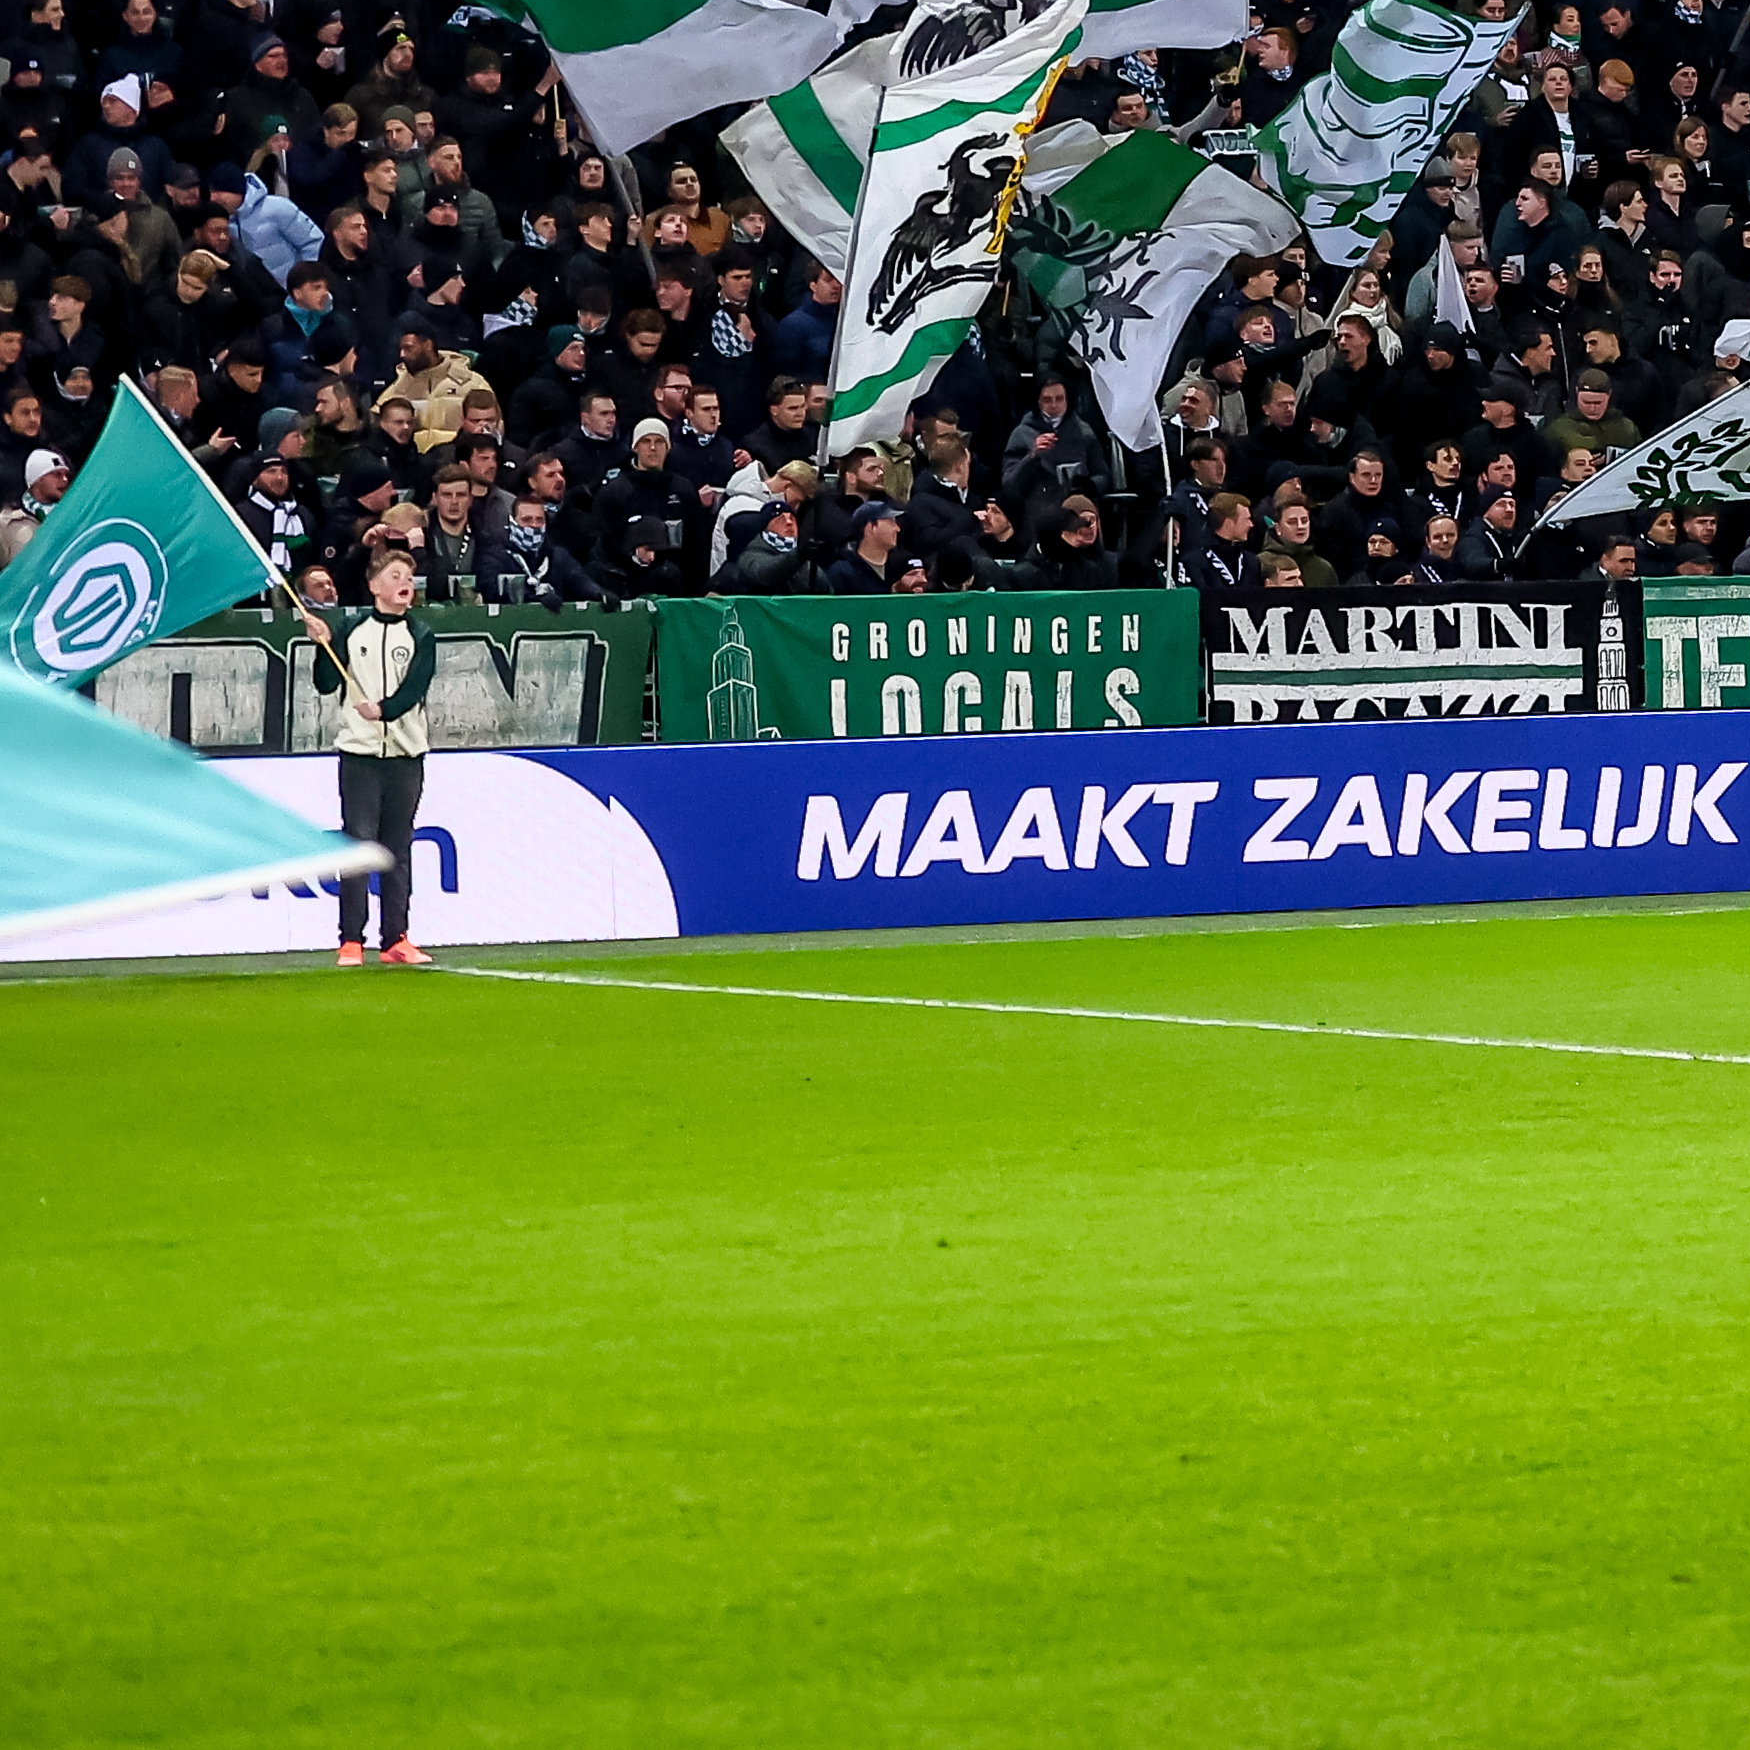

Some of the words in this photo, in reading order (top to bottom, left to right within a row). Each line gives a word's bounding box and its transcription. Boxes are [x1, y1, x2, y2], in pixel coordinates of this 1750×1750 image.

[831, 614, 1141, 662] GRONINGEN
[1219, 601, 1574, 656] MARTINI
[796, 779, 1220, 881] MAAKT
[1242, 761, 1749, 863] ZAKELIJK
